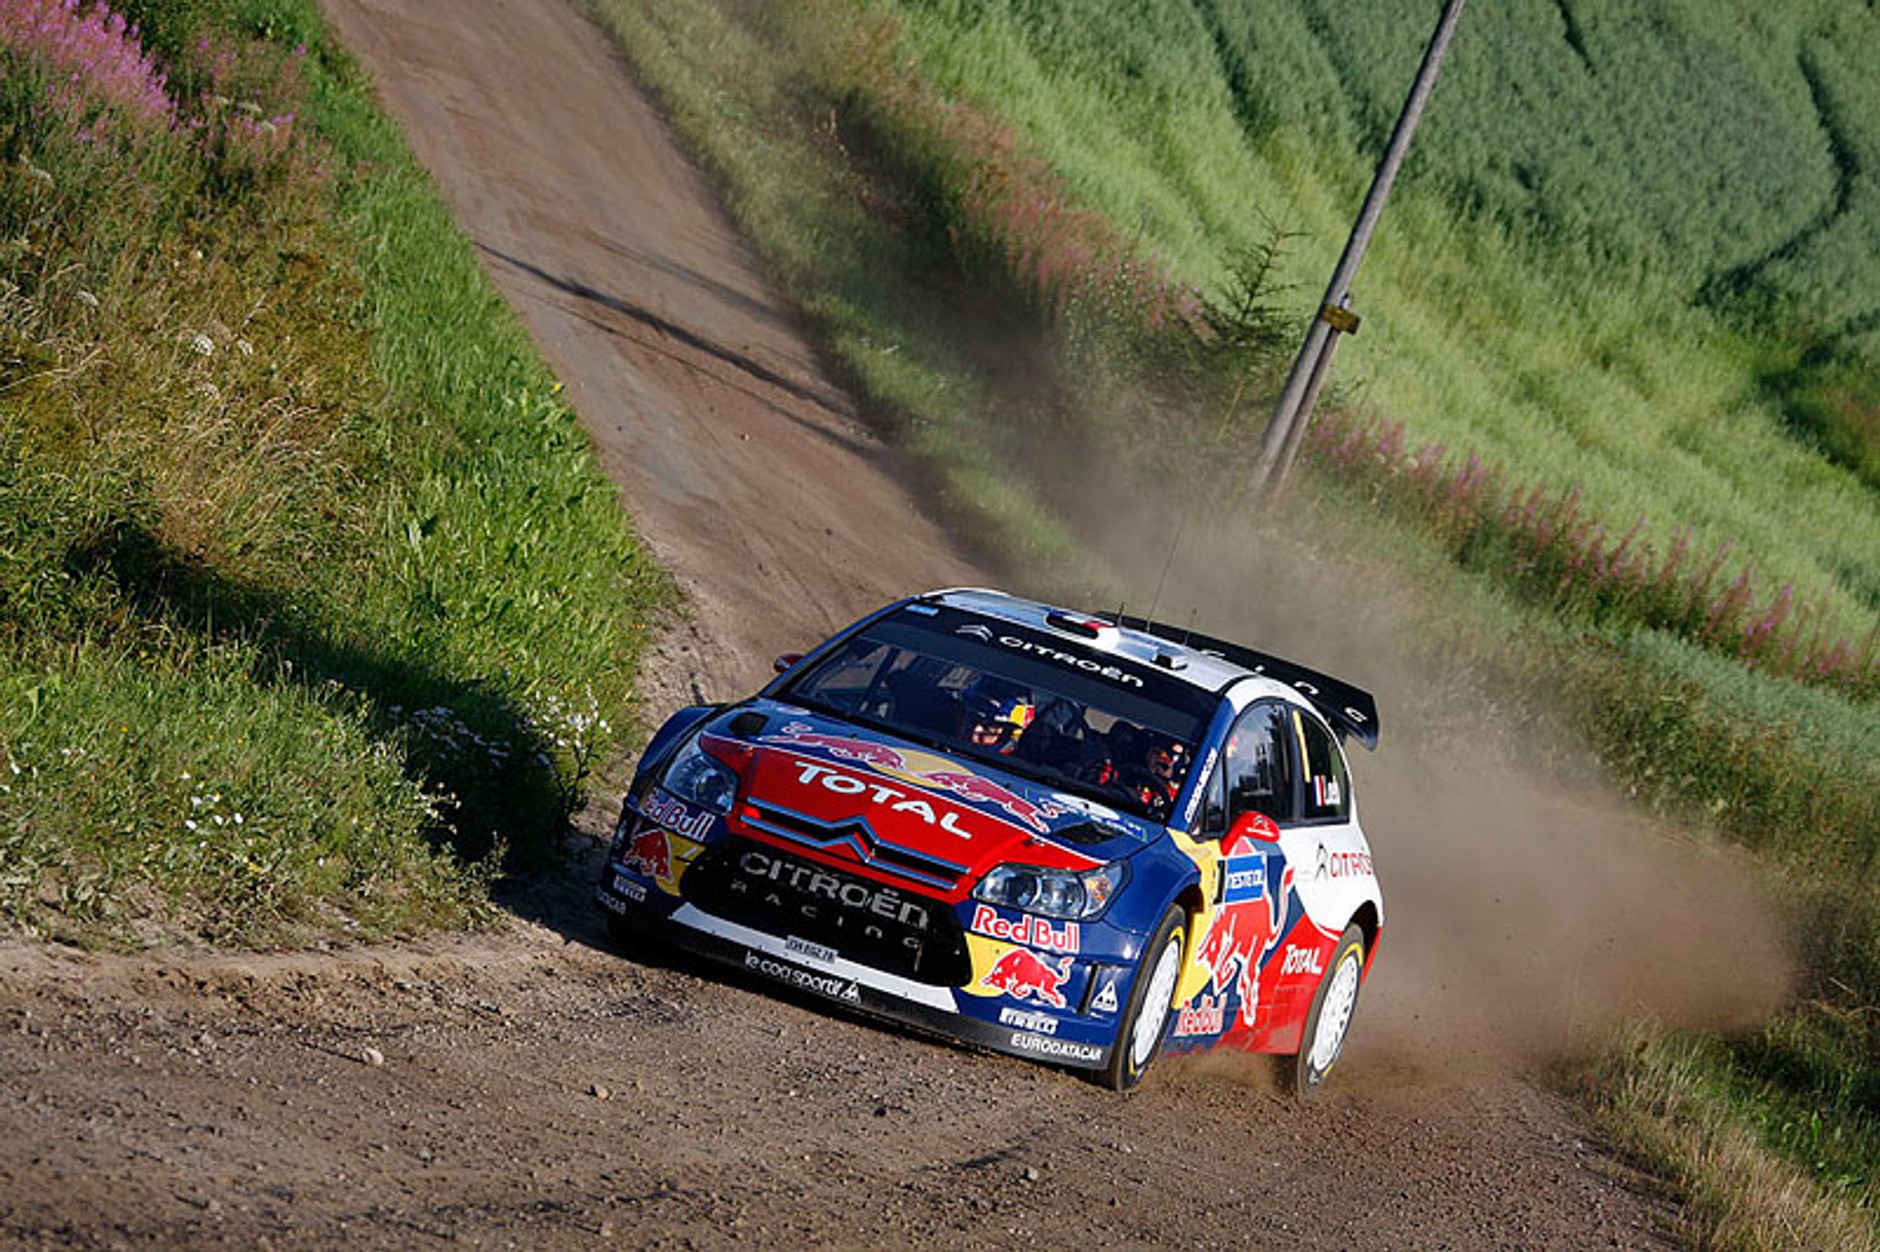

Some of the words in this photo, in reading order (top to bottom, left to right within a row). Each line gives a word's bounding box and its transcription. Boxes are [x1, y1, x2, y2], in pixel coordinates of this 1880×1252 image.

[663, 804, 716, 842] Bull
[794, 761, 972, 840] TOTAL
[971, 904, 1032, 945] Red
[1031, 918, 1080, 953] Bull
[745, 950, 759, 968] le
[792, 970, 842, 996] sportif
[1280, 944, 1322, 976] TOTAL
